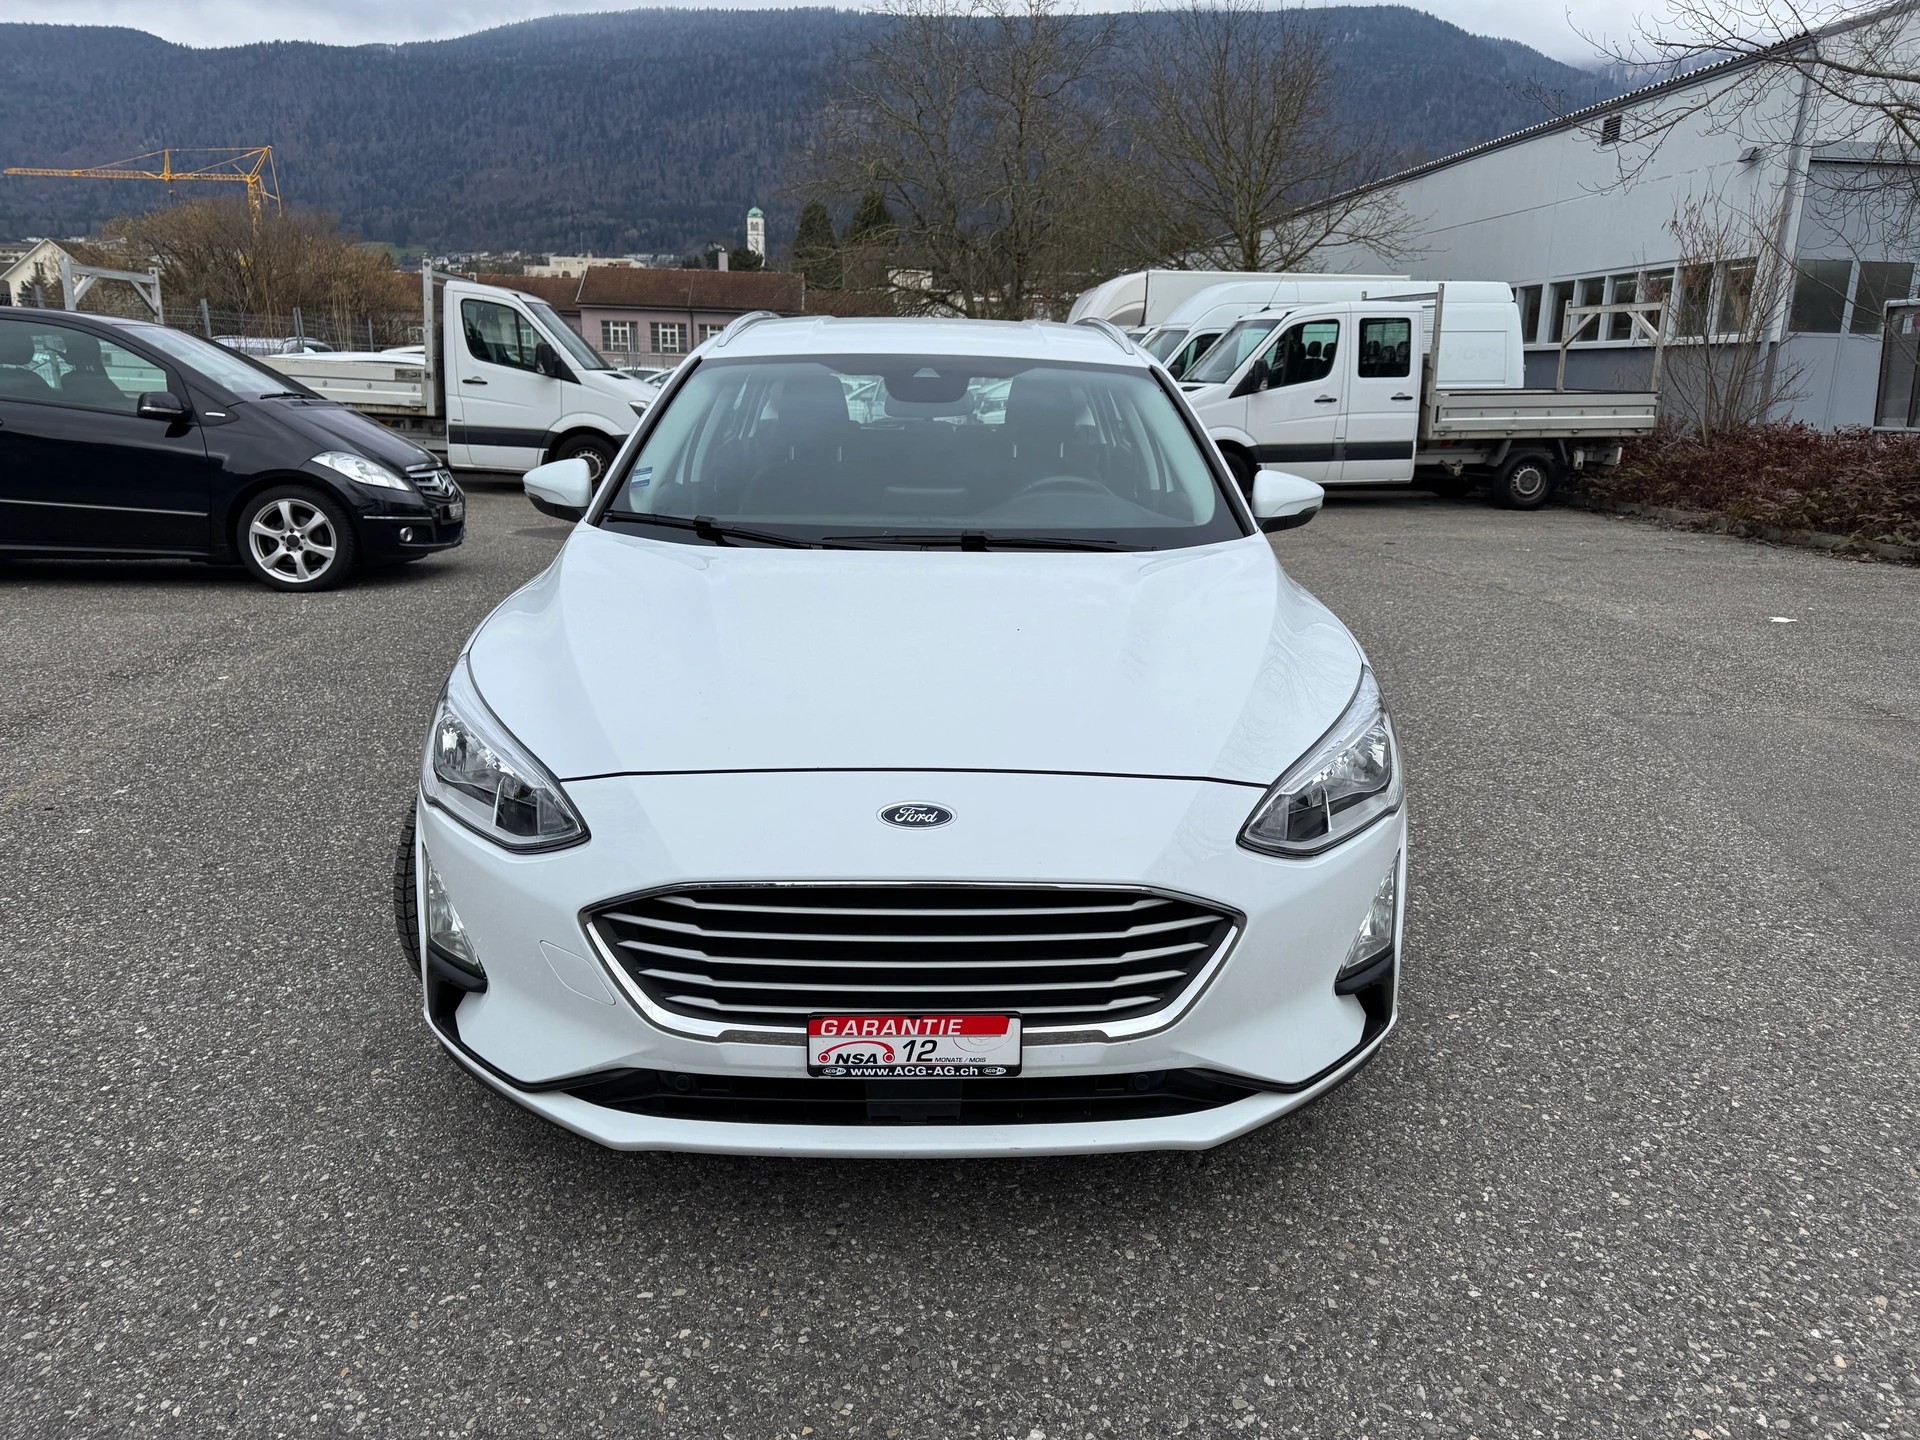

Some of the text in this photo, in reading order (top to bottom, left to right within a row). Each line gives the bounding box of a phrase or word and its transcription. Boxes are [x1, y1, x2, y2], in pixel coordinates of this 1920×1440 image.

[894, 806, 938, 823] Ford
[820, 1018, 963, 1036] GARANTIE
[834, 1053, 878, 1065] NSA
[902, 1039, 937, 1062] 12
[850, 1066, 978, 1076] www.ACG-AG.ch
